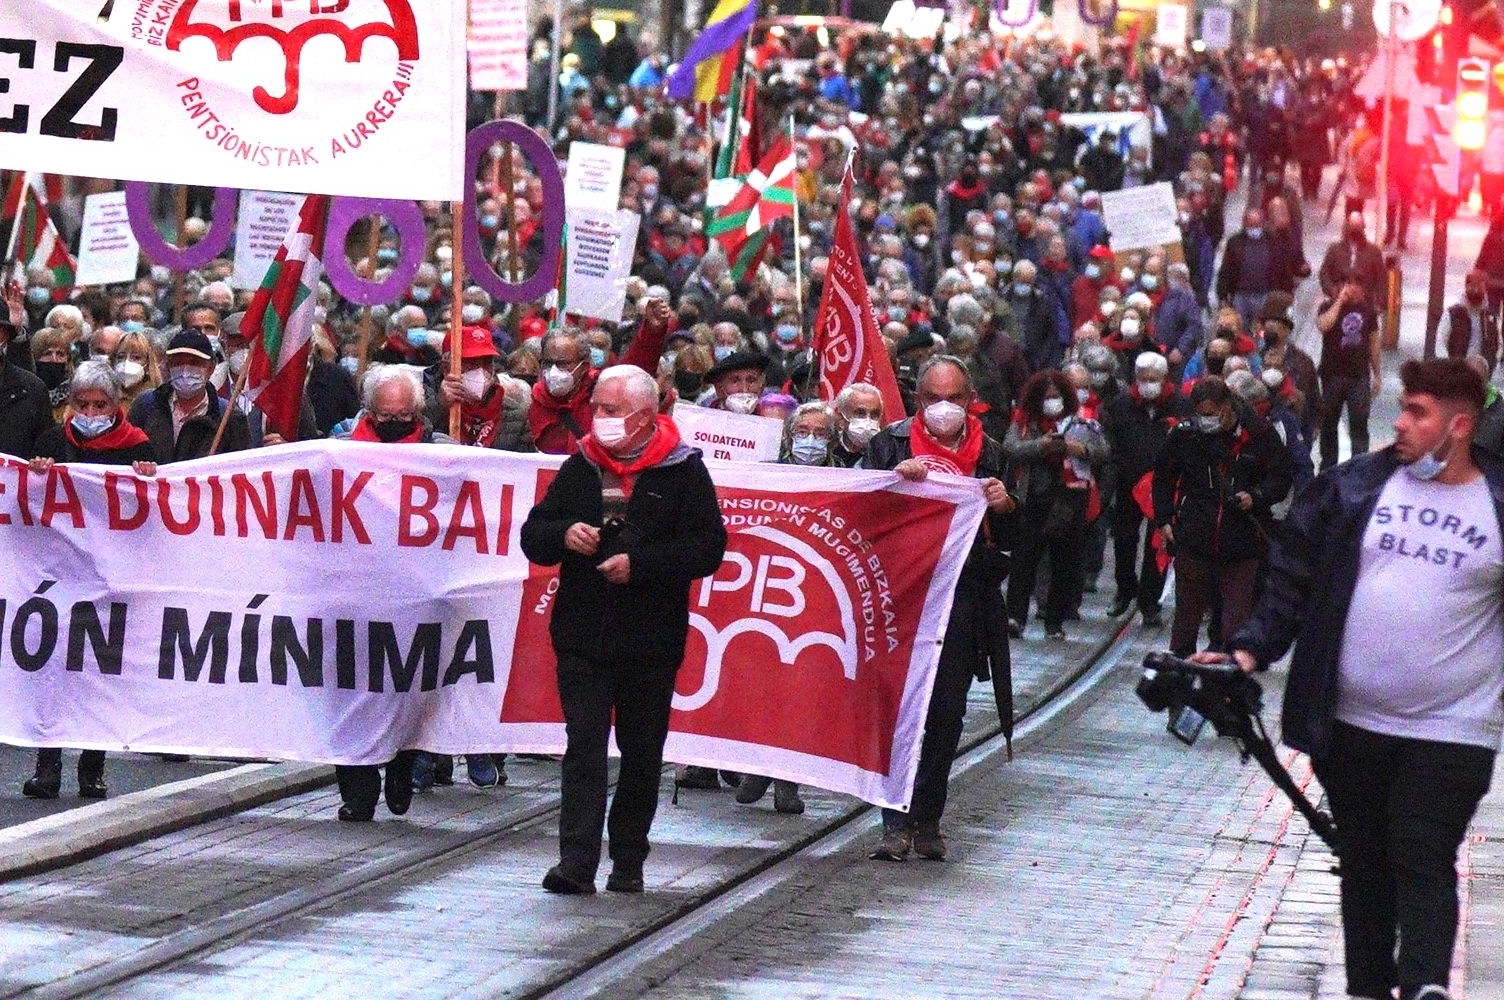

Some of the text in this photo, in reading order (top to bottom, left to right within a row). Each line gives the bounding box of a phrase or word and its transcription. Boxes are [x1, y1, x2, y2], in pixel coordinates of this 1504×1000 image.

[176, 77, 319, 167] PENTSIONISTAK
[694, 431, 756, 450] SOLDATETAN
[713, 449, 731, 460] ETA
[103, 466, 372, 547] DUINAK
[397, 475, 514, 557] BAI
[1376, 504, 1489, 550] STORM
[1379, 532, 1467, 569] BLAST
[698, 551, 806, 617] PB
[808, 523, 875, 662] MUGIMENDUA
[867, 555, 899, 653] BIZKAIA
[158, 594, 495, 694] MÍNIMA
